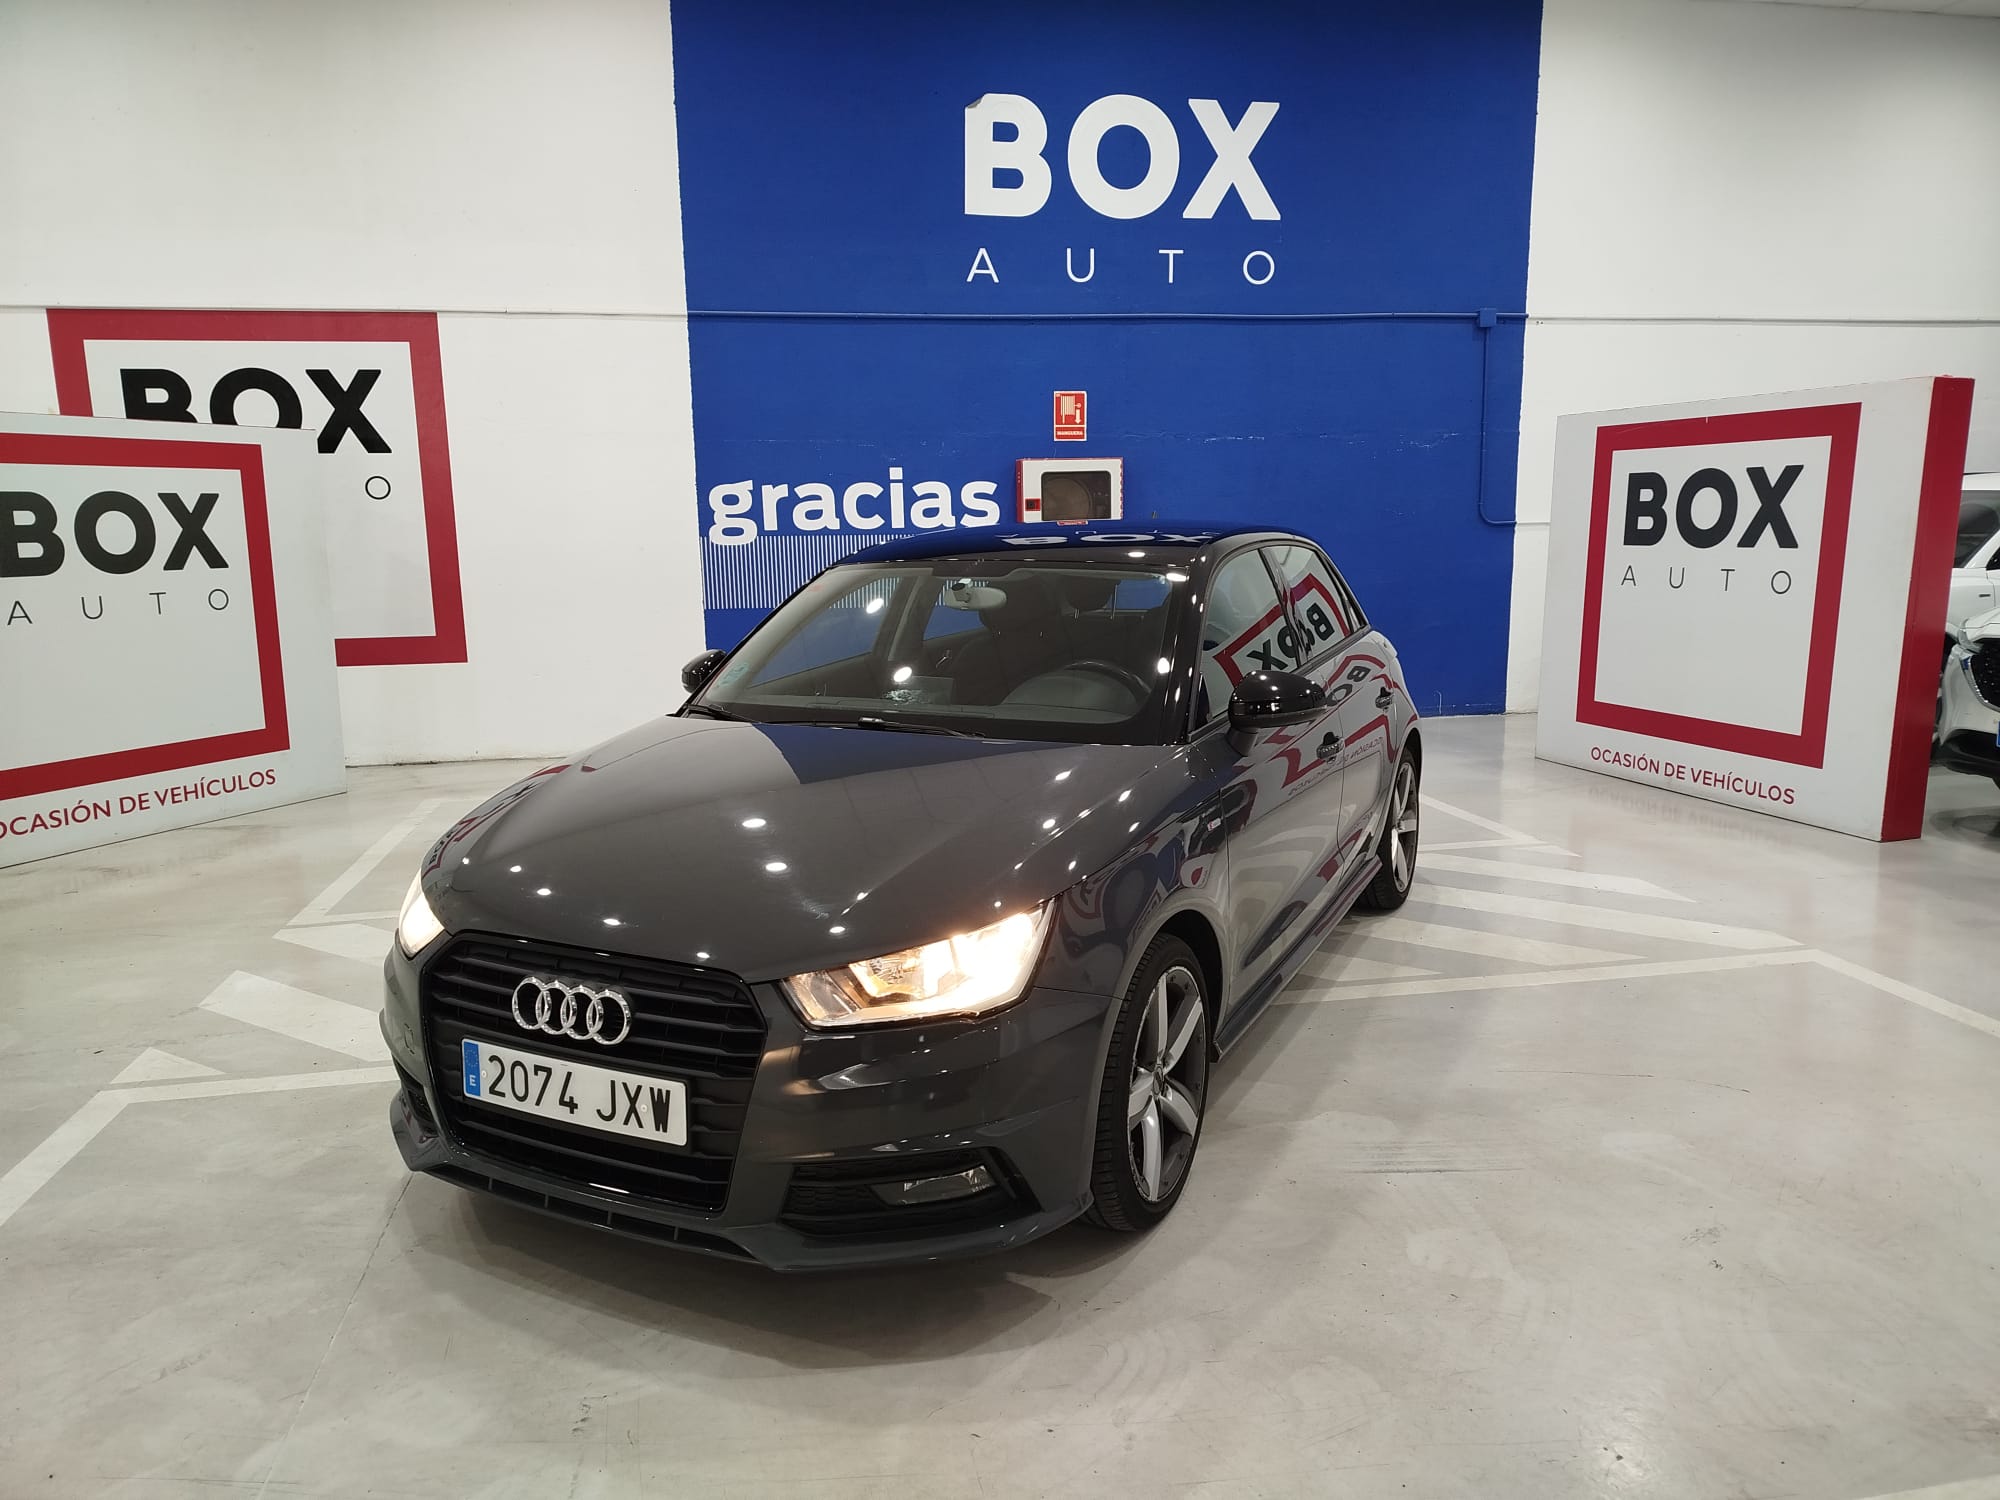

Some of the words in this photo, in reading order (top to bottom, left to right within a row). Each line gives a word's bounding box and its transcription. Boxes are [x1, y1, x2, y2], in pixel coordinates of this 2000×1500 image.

[965, 93, 1281, 221] BOX
[967, 248, 1276, 285] AUTO
[120, 367, 393, 454] BOX
[0, 490, 229, 578] BOX
[708, 466, 1000, 546] gracias
[1623, 464, 1804, 549] BOX
[7, 588, 229, 626] AUTO
[1621, 565, 1792, 595] AUTO
[119, 792, 150, 814] DE
[154, 768, 276, 807] VEHÍCULOS
[1591, 746, 1660, 775] OCASIÓN
[1664, 762, 1687, 780] DE
[1691, 767, 1796, 805] VEHÍCULOS
[469, 1075, 477, 1087] E
[487, 1054, 579, 1115] 2074
[595, 1079, 671, 1134] JXW
